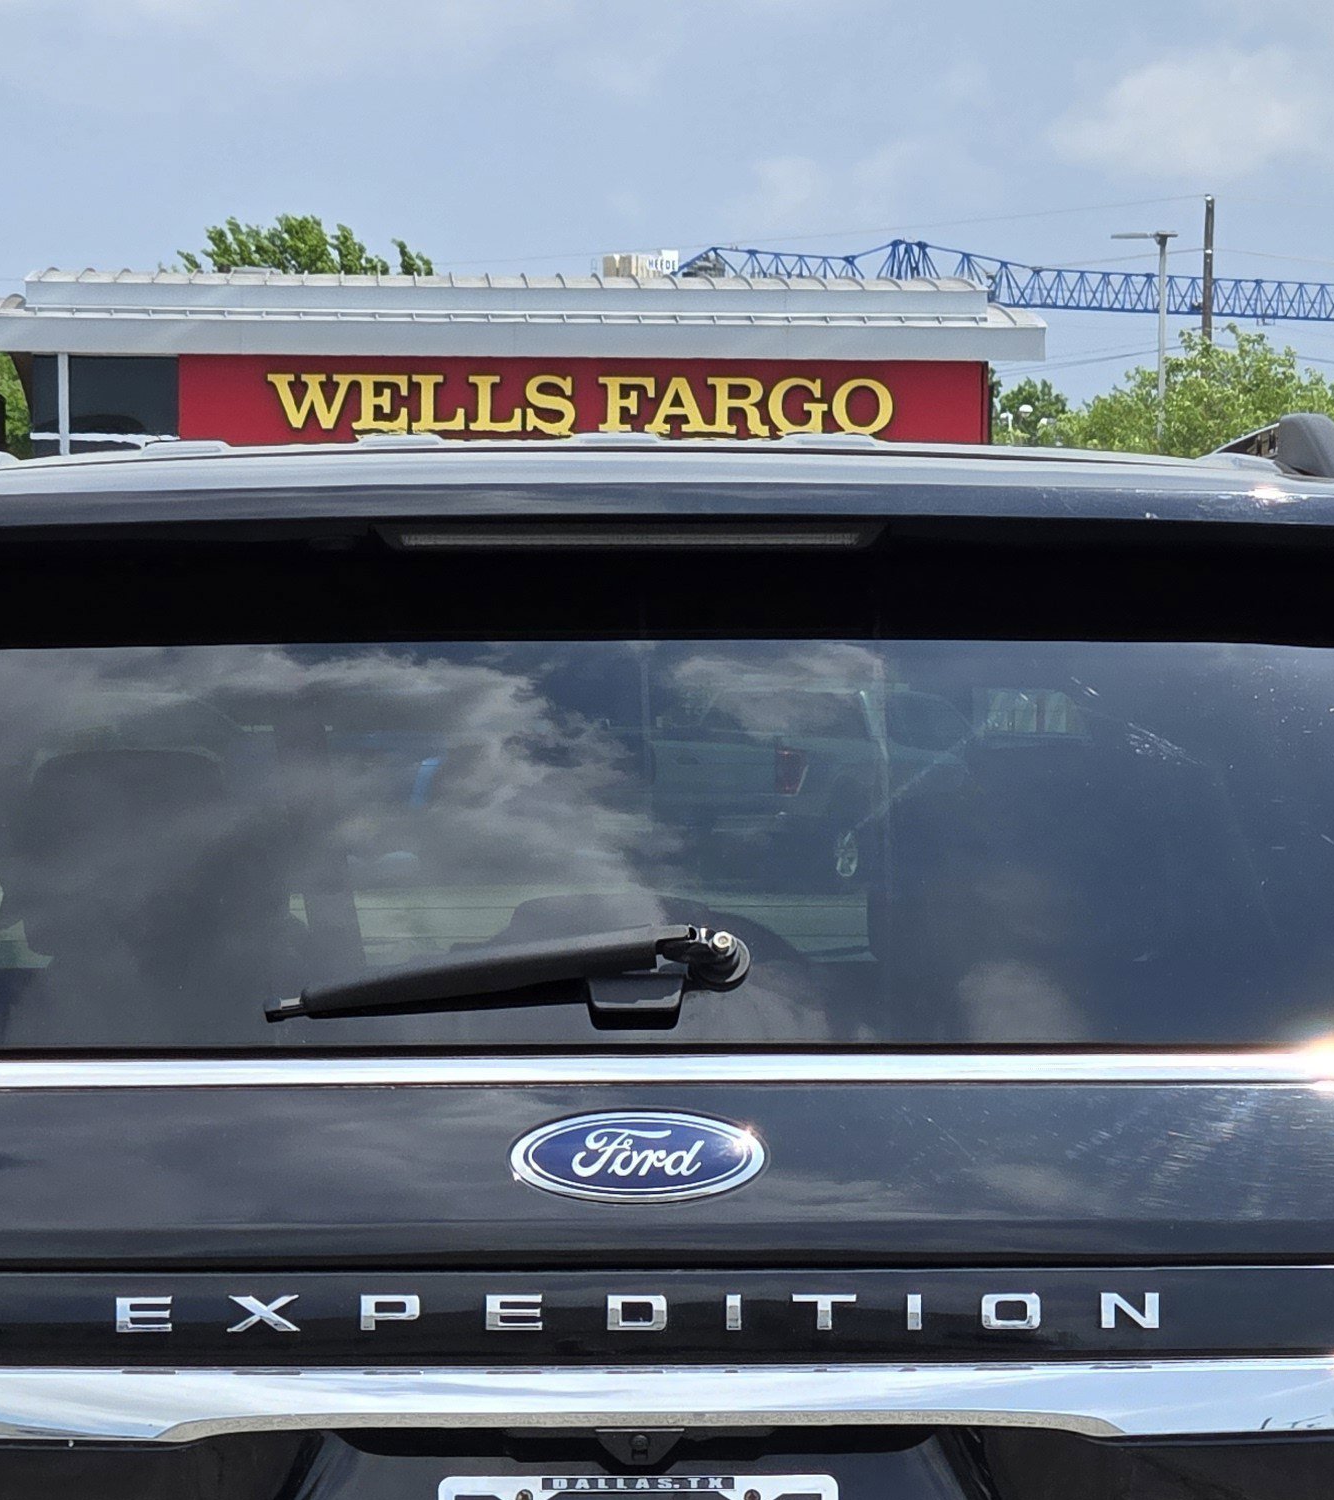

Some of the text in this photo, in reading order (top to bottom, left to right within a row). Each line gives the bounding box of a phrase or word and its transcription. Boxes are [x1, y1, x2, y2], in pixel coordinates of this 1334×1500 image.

[267, 373, 895, 435] WELLS FARGO
[571, 1127, 705, 1177] Ford
[115, 1292, 1160, 1334] EXPEDITION
[688, 1477, 724, 1489] TX
